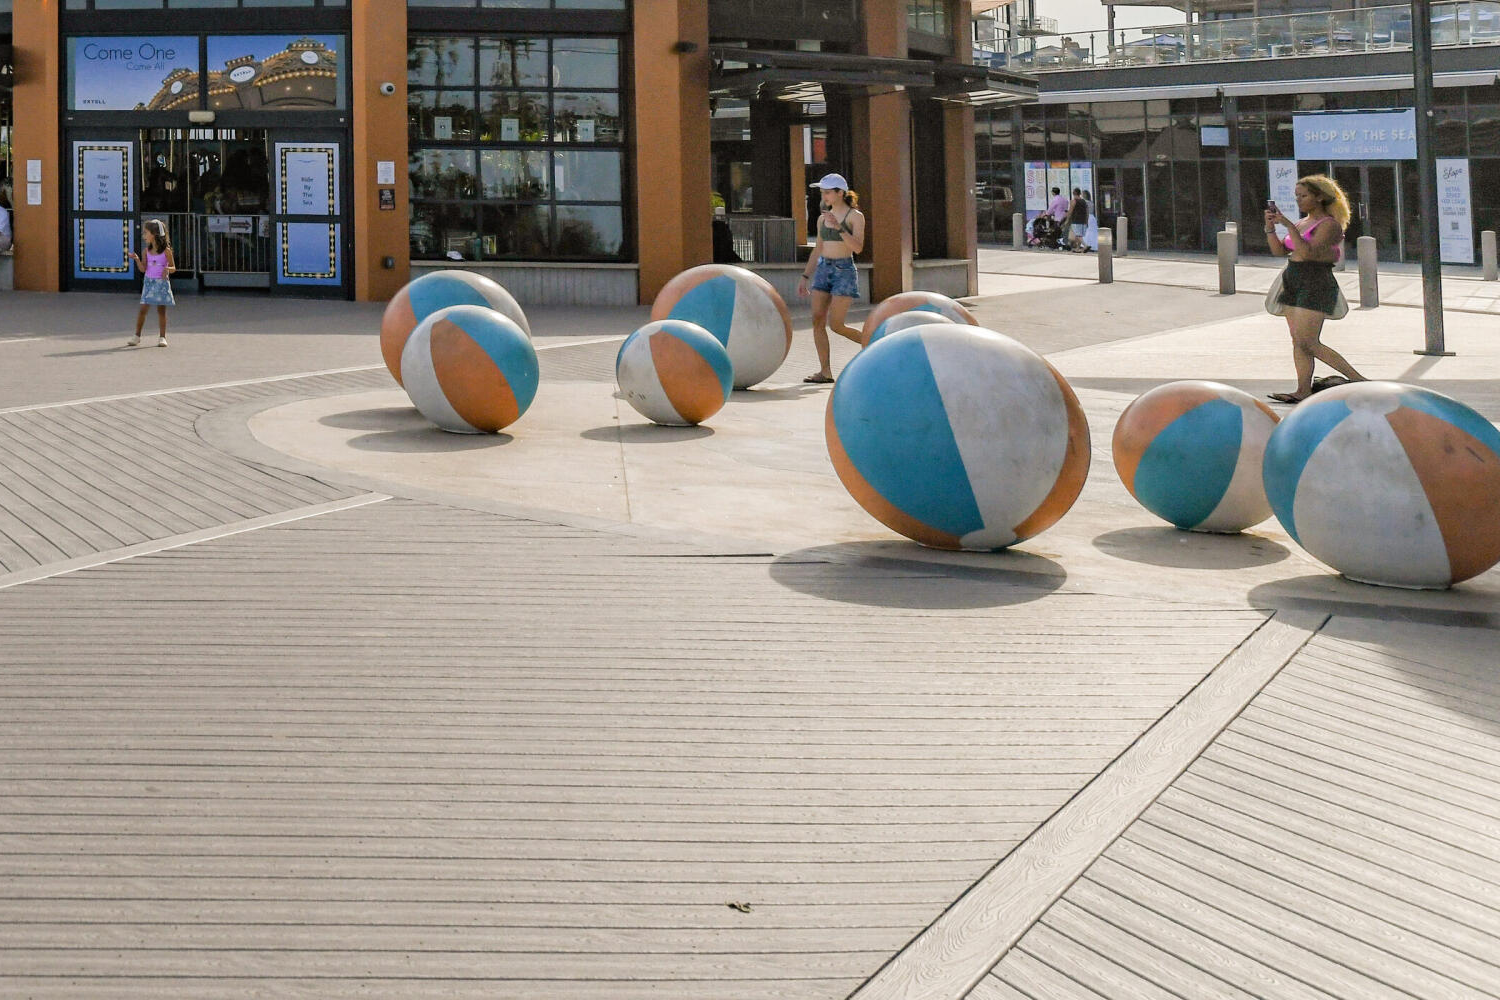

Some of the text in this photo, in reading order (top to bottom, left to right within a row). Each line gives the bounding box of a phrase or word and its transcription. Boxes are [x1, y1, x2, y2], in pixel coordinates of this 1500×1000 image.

[83, 43, 176, 60] Come One
[125, 61, 165, 71] Come All
[1304, 128, 1416, 142] SHOP BY THE SEA
